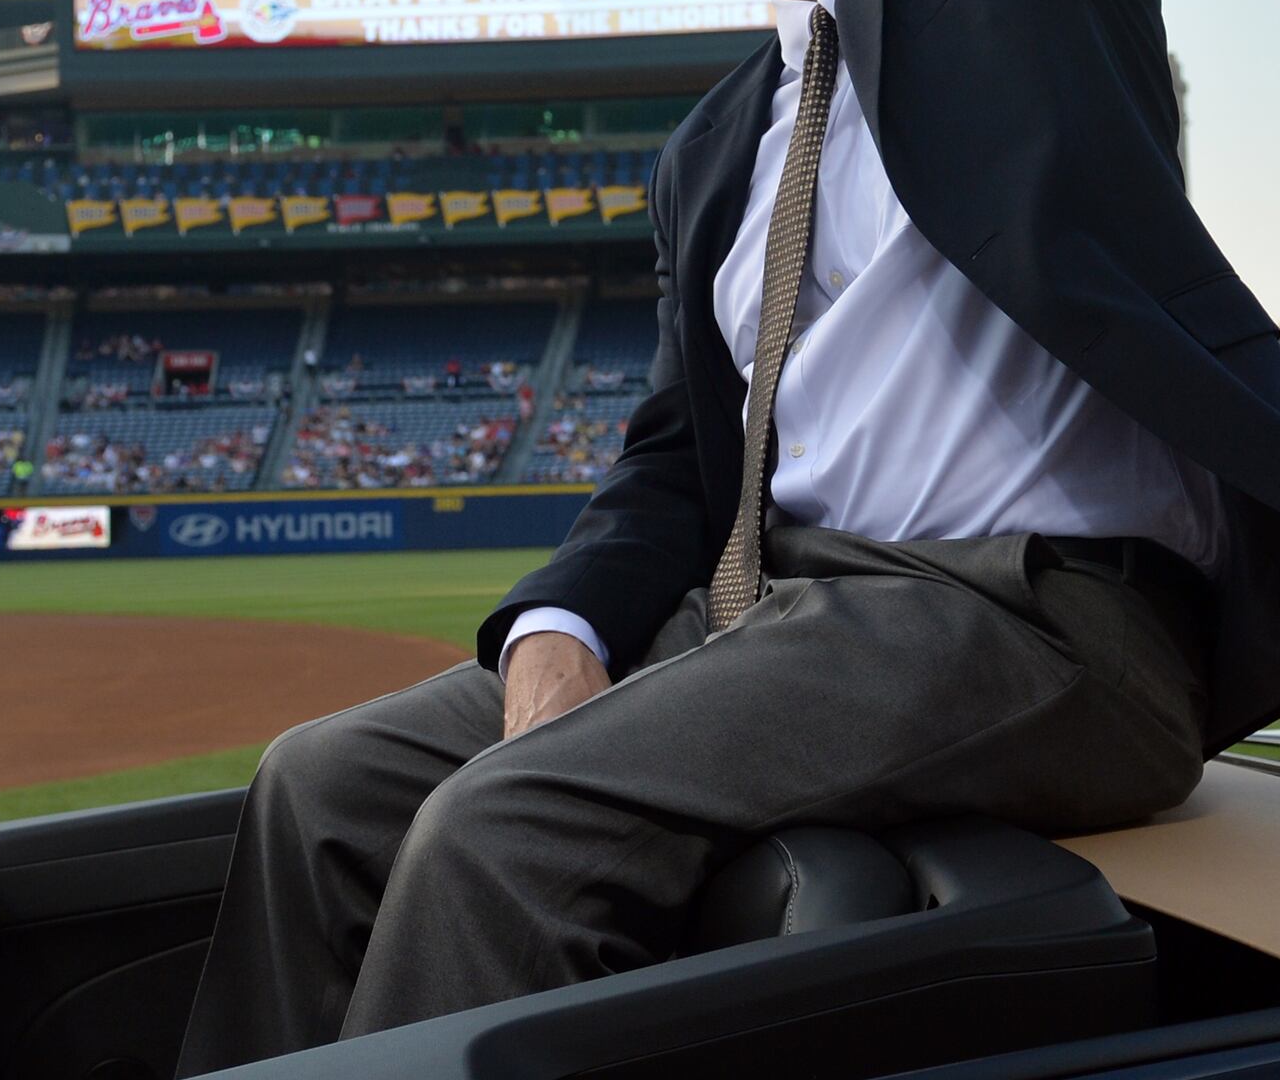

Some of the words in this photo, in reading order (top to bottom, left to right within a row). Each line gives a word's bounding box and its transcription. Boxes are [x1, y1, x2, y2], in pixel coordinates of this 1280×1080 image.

[362, 14, 479, 43] THANKS
[487, 12, 545, 38] FOR
[556, 9, 611, 36] THE
[620, 2, 768, 31] MEMORIES
[235, 511, 394, 543] HYUNDAI
